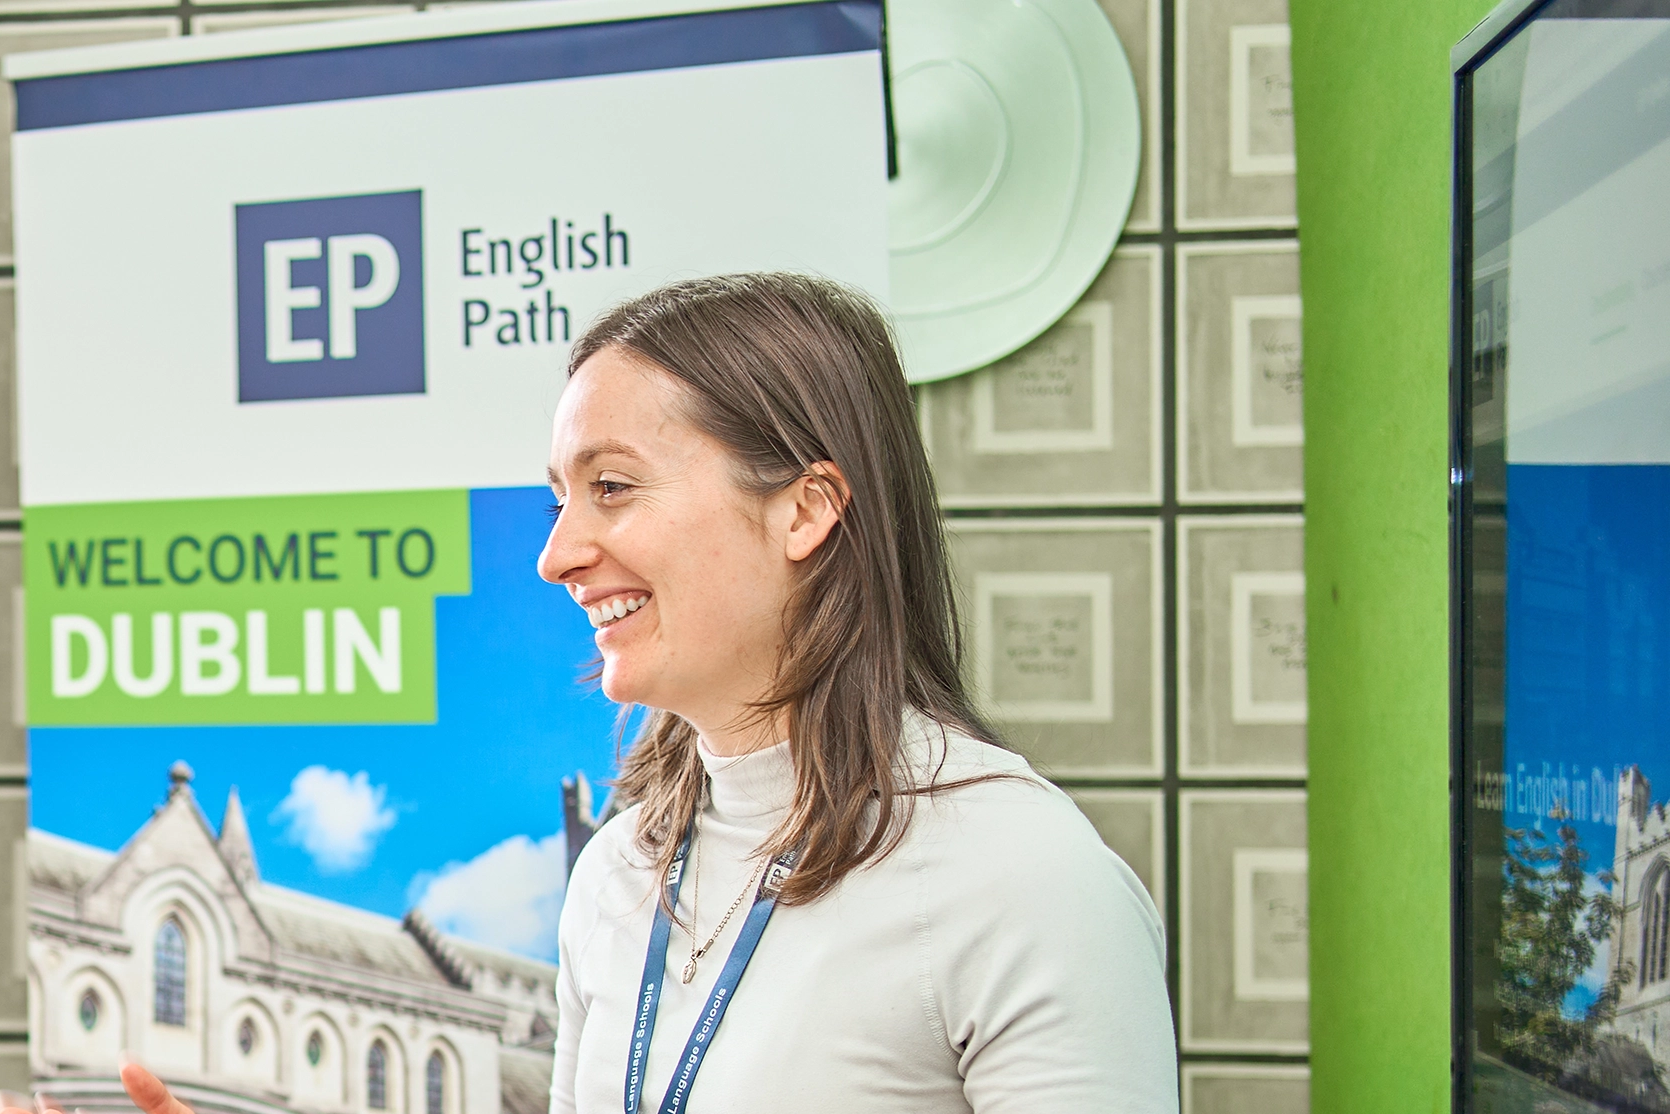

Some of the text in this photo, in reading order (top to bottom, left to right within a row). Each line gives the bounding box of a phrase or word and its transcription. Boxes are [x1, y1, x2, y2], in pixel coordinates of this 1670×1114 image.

[461, 214, 629, 289] English
[264, 233, 400, 363] EP
[462, 289, 570, 347] Path
[48, 527, 436, 588] WELCOME TO
[51, 606, 402, 698] DUBLIN
[636, 982, 655, 1038] Schools
[667, 1045, 700, 1114] Language
[696, 986, 727, 1043] Schools
